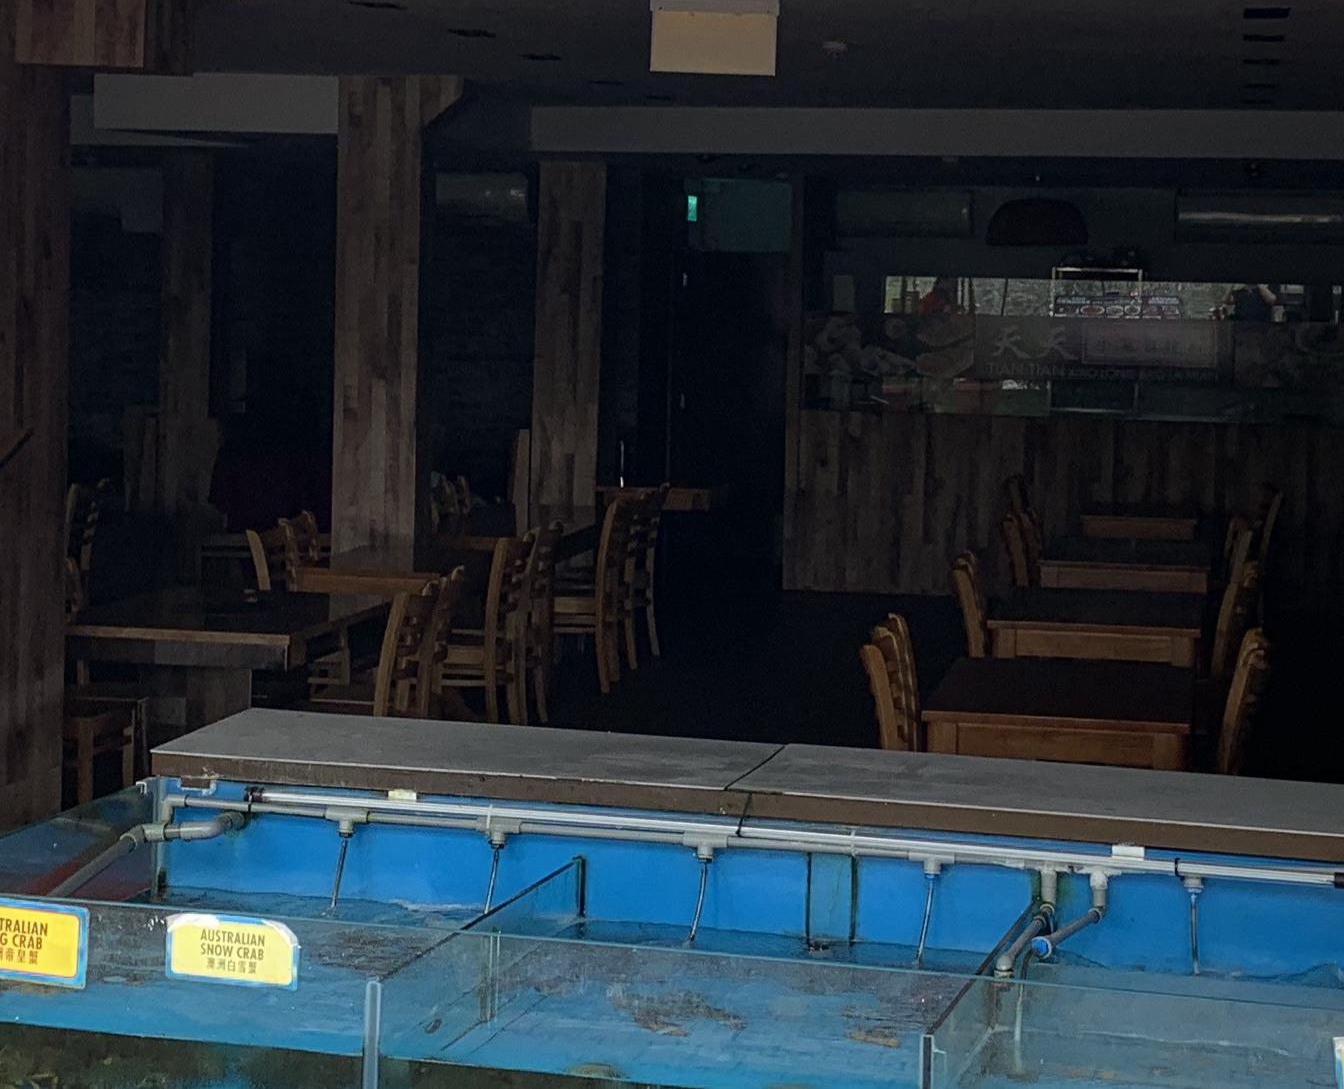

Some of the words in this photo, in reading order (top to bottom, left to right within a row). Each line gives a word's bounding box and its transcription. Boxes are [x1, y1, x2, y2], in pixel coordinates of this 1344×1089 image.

[12, 934, 43, 950] CRAB
[200, 929, 265, 946] AUSTRALIAN
[201, 943, 233, 957] SNOW
[237, 947, 264, 961] CRAB
